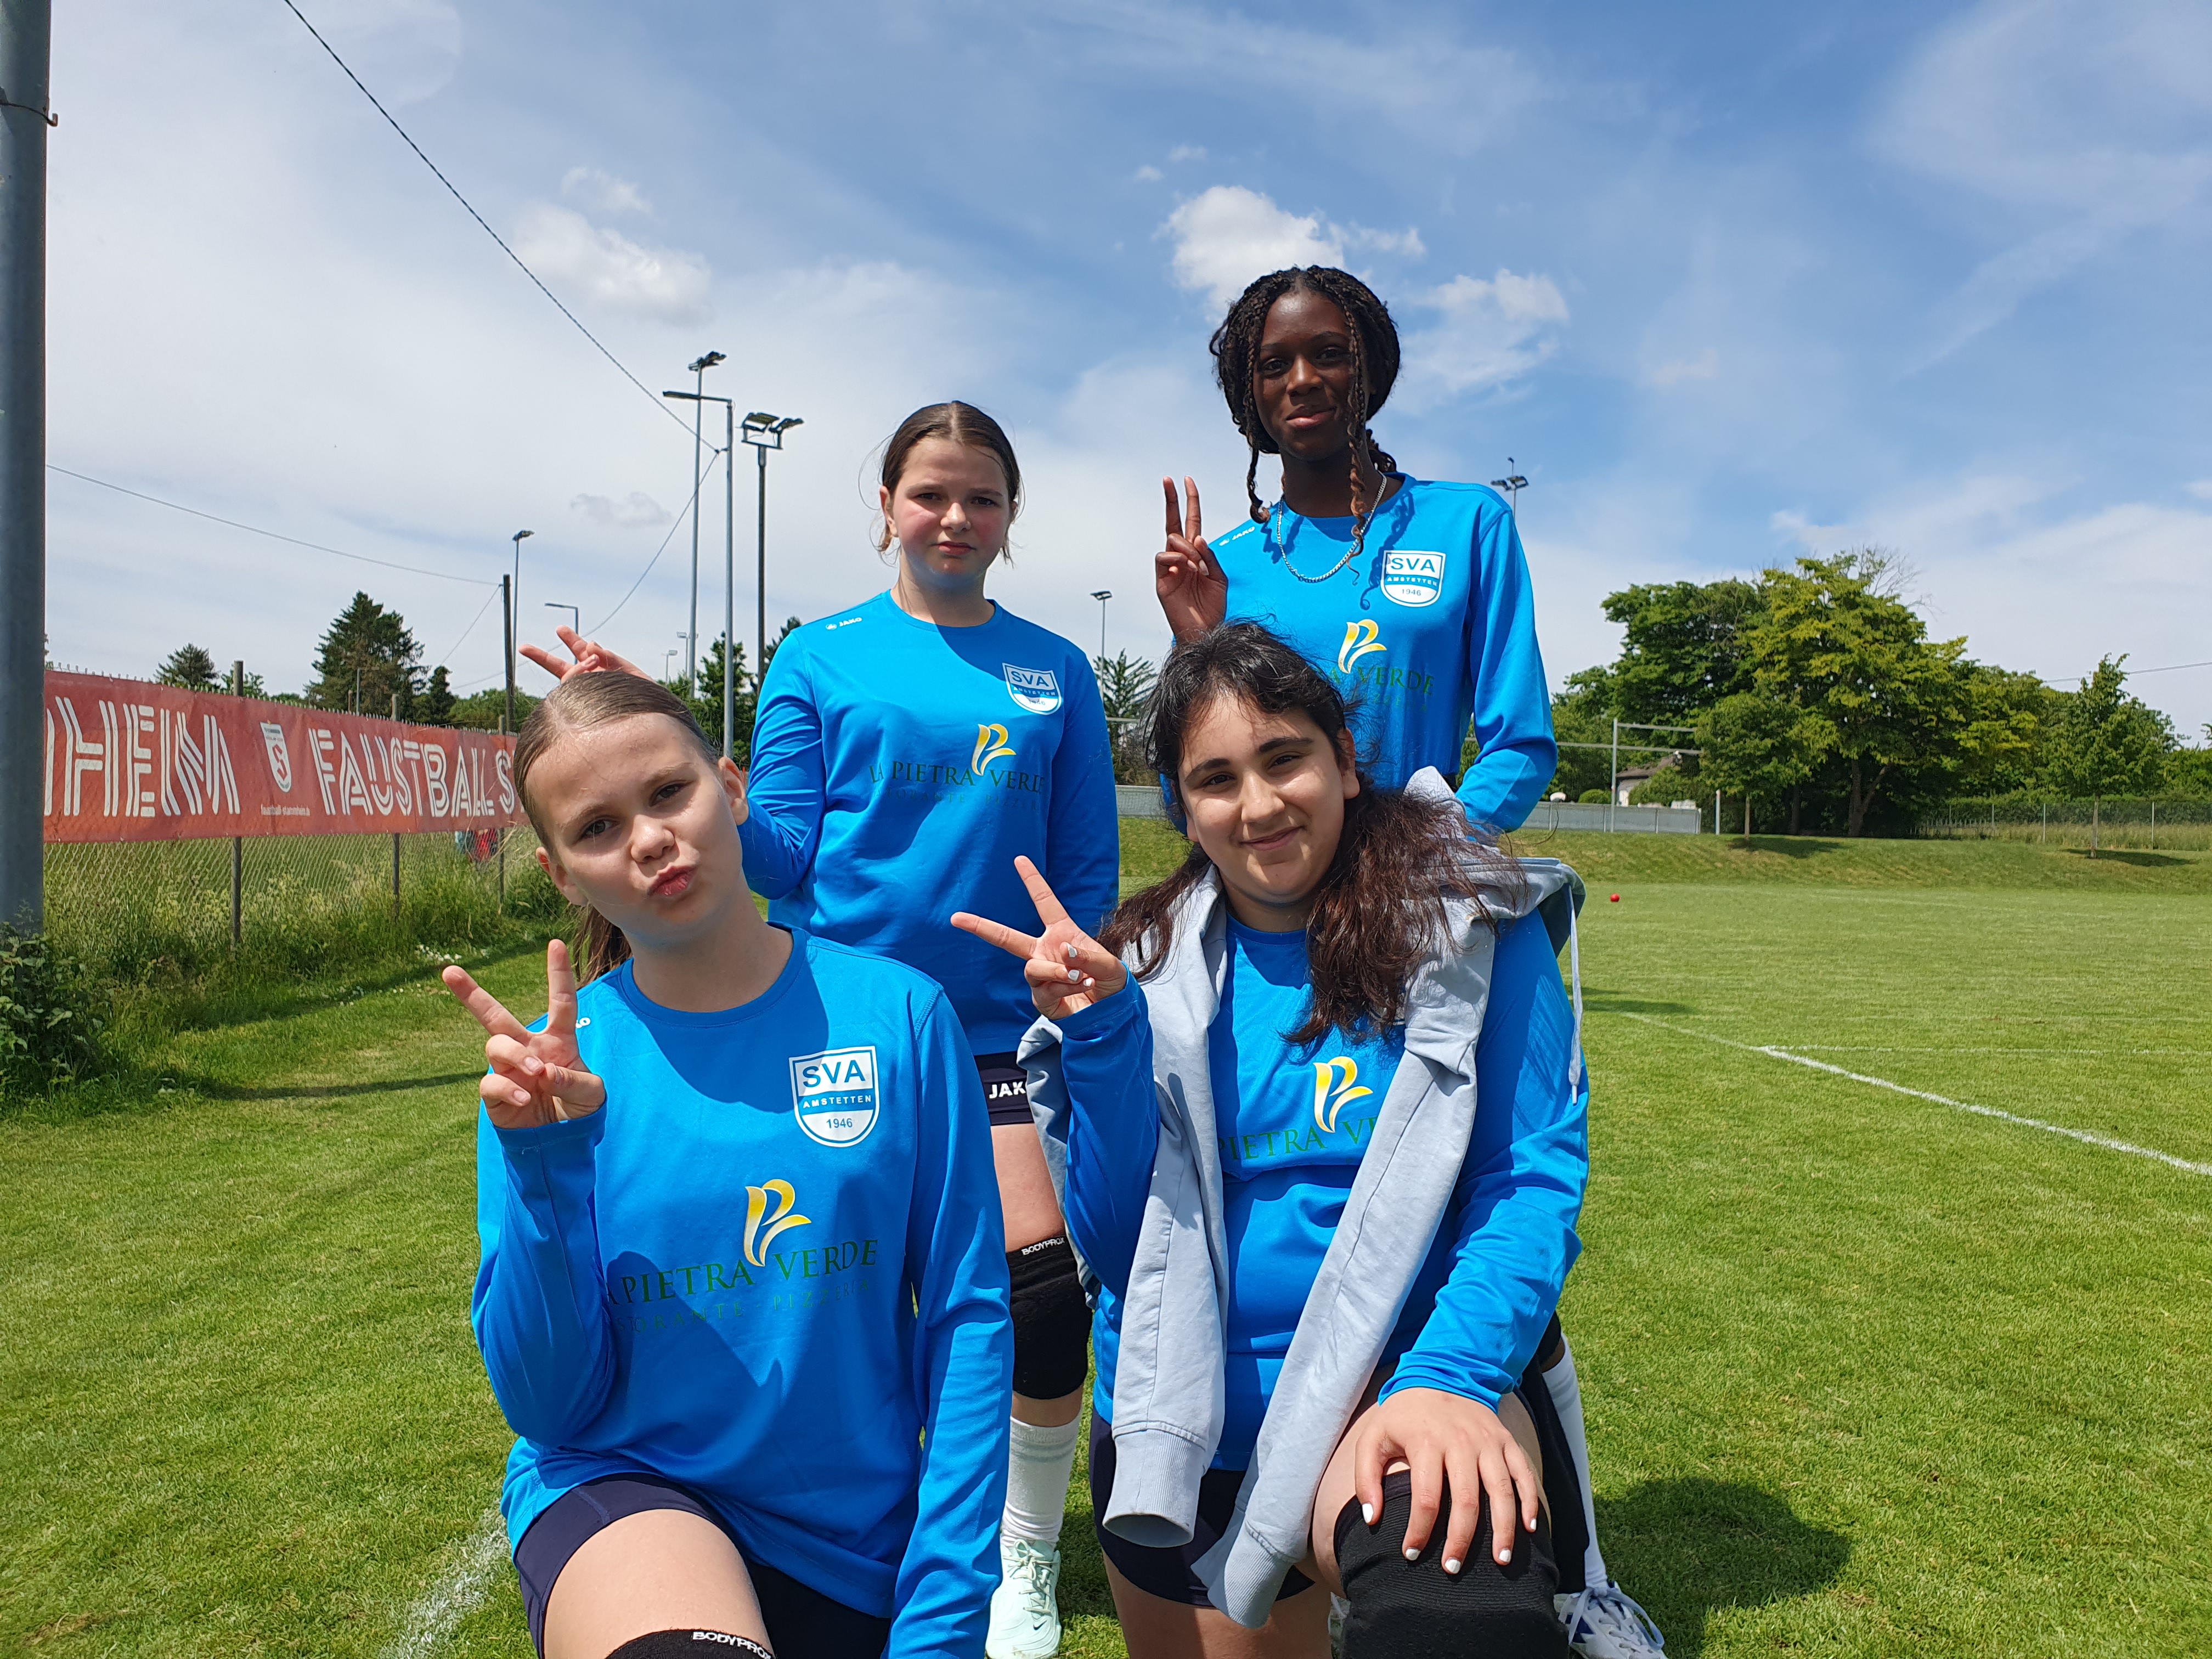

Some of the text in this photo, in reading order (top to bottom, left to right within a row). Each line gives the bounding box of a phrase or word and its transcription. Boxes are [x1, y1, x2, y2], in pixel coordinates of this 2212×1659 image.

[1391, 557, 1436, 573] SVA
[1387, 577, 1437, 586] AMSTETTEN
[839, 617, 862, 627] JAKO
[1011, 671, 1050, 687] SVA
[1358, 666, 1435, 696] VERDE
[308, 728, 495, 817] FAUSTBALL
[869, 762, 884, 783] LA
[892, 760, 977, 787] PIETRA
[802, 1059, 866, 1088] SVA
[989, 1081, 1026, 1099] JAK
[803, 1095, 872, 1109] AMSTETTEN
[826, 1118, 853, 1129] 1946
[620, 1259, 757, 1304] PIETRA
[772, 1239, 878, 1281] VERDE
[774, 1278, 869, 1311] PIZZERIA
